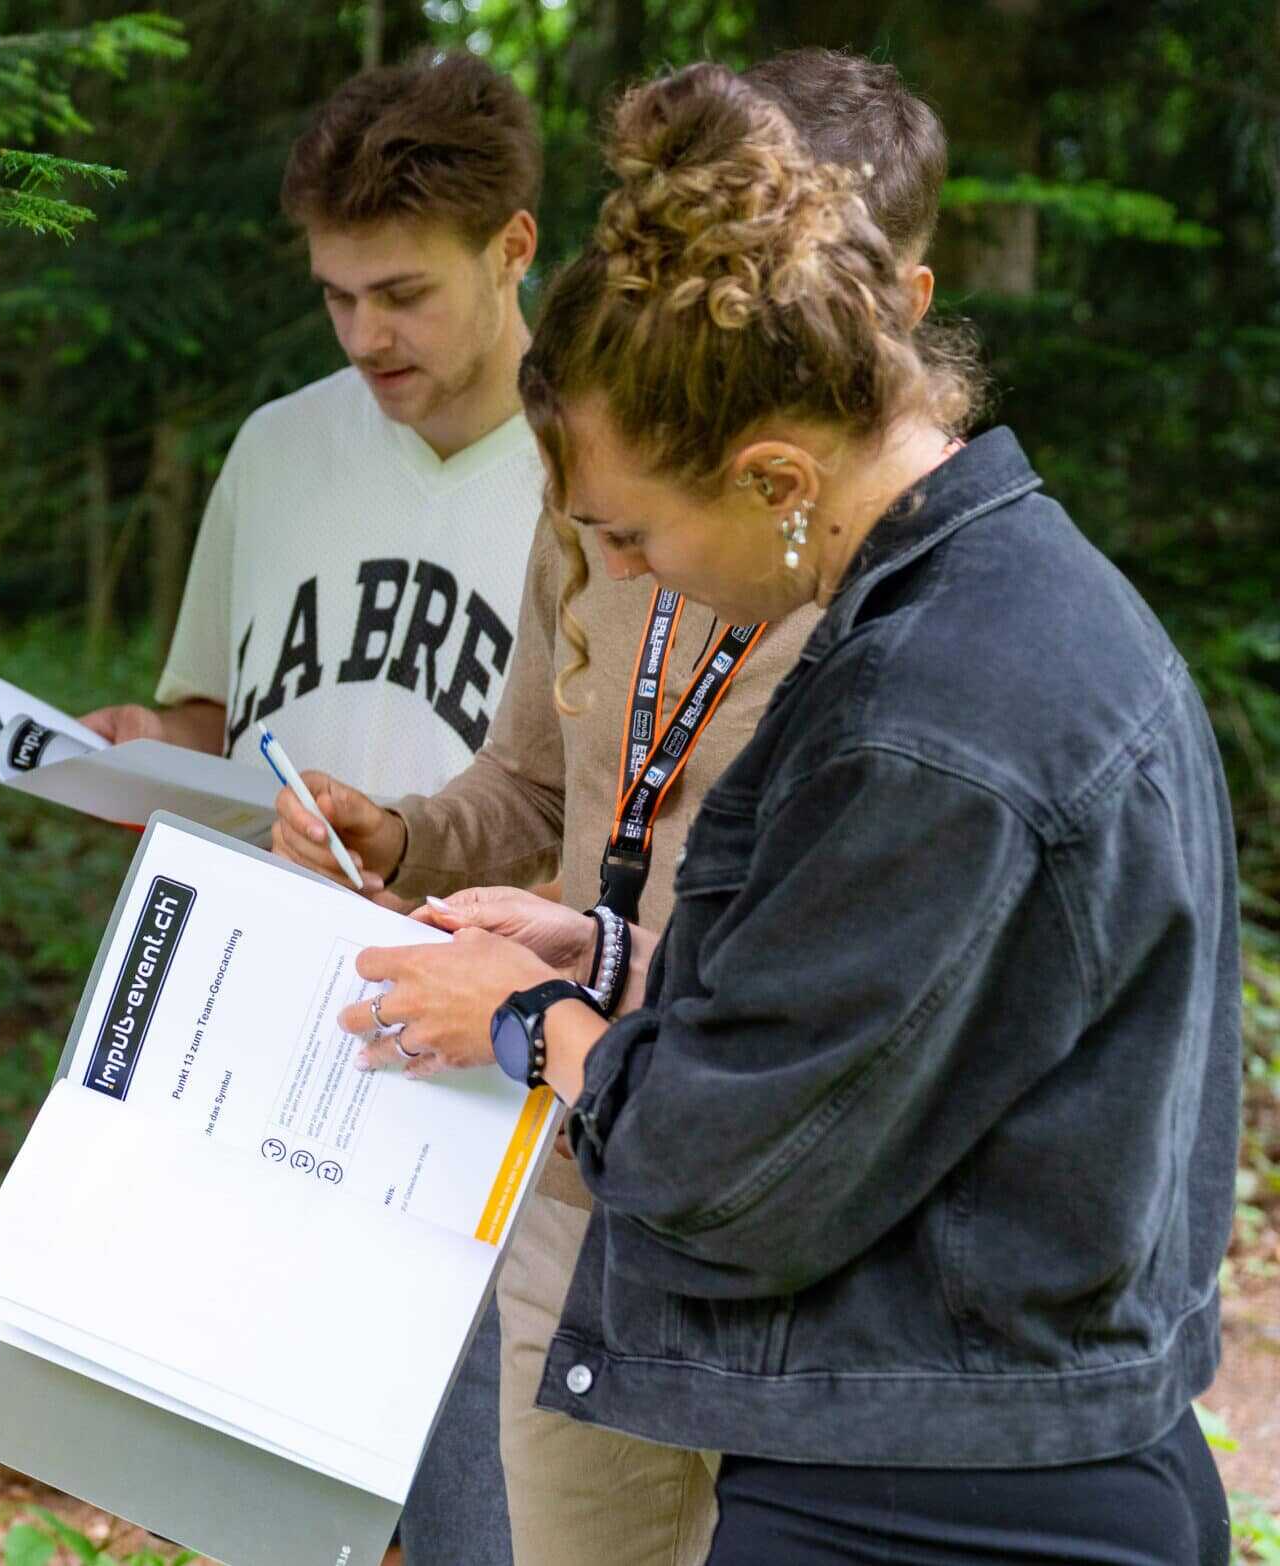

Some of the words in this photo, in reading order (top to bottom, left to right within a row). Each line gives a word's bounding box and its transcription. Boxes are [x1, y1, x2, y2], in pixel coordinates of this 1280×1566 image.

[680, 673, 715, 725] ERLEBNIS
[196, 927, 243, 1029] Team-Geocaching
[190, 1029, 204, 1054] zum
[184, 1054, 195, 1067] 13
[172, 1069, 190, 1100] Punkt
[214, 1070, 234, 1105] Symbol
[210, 1106, 221, 1122] das
